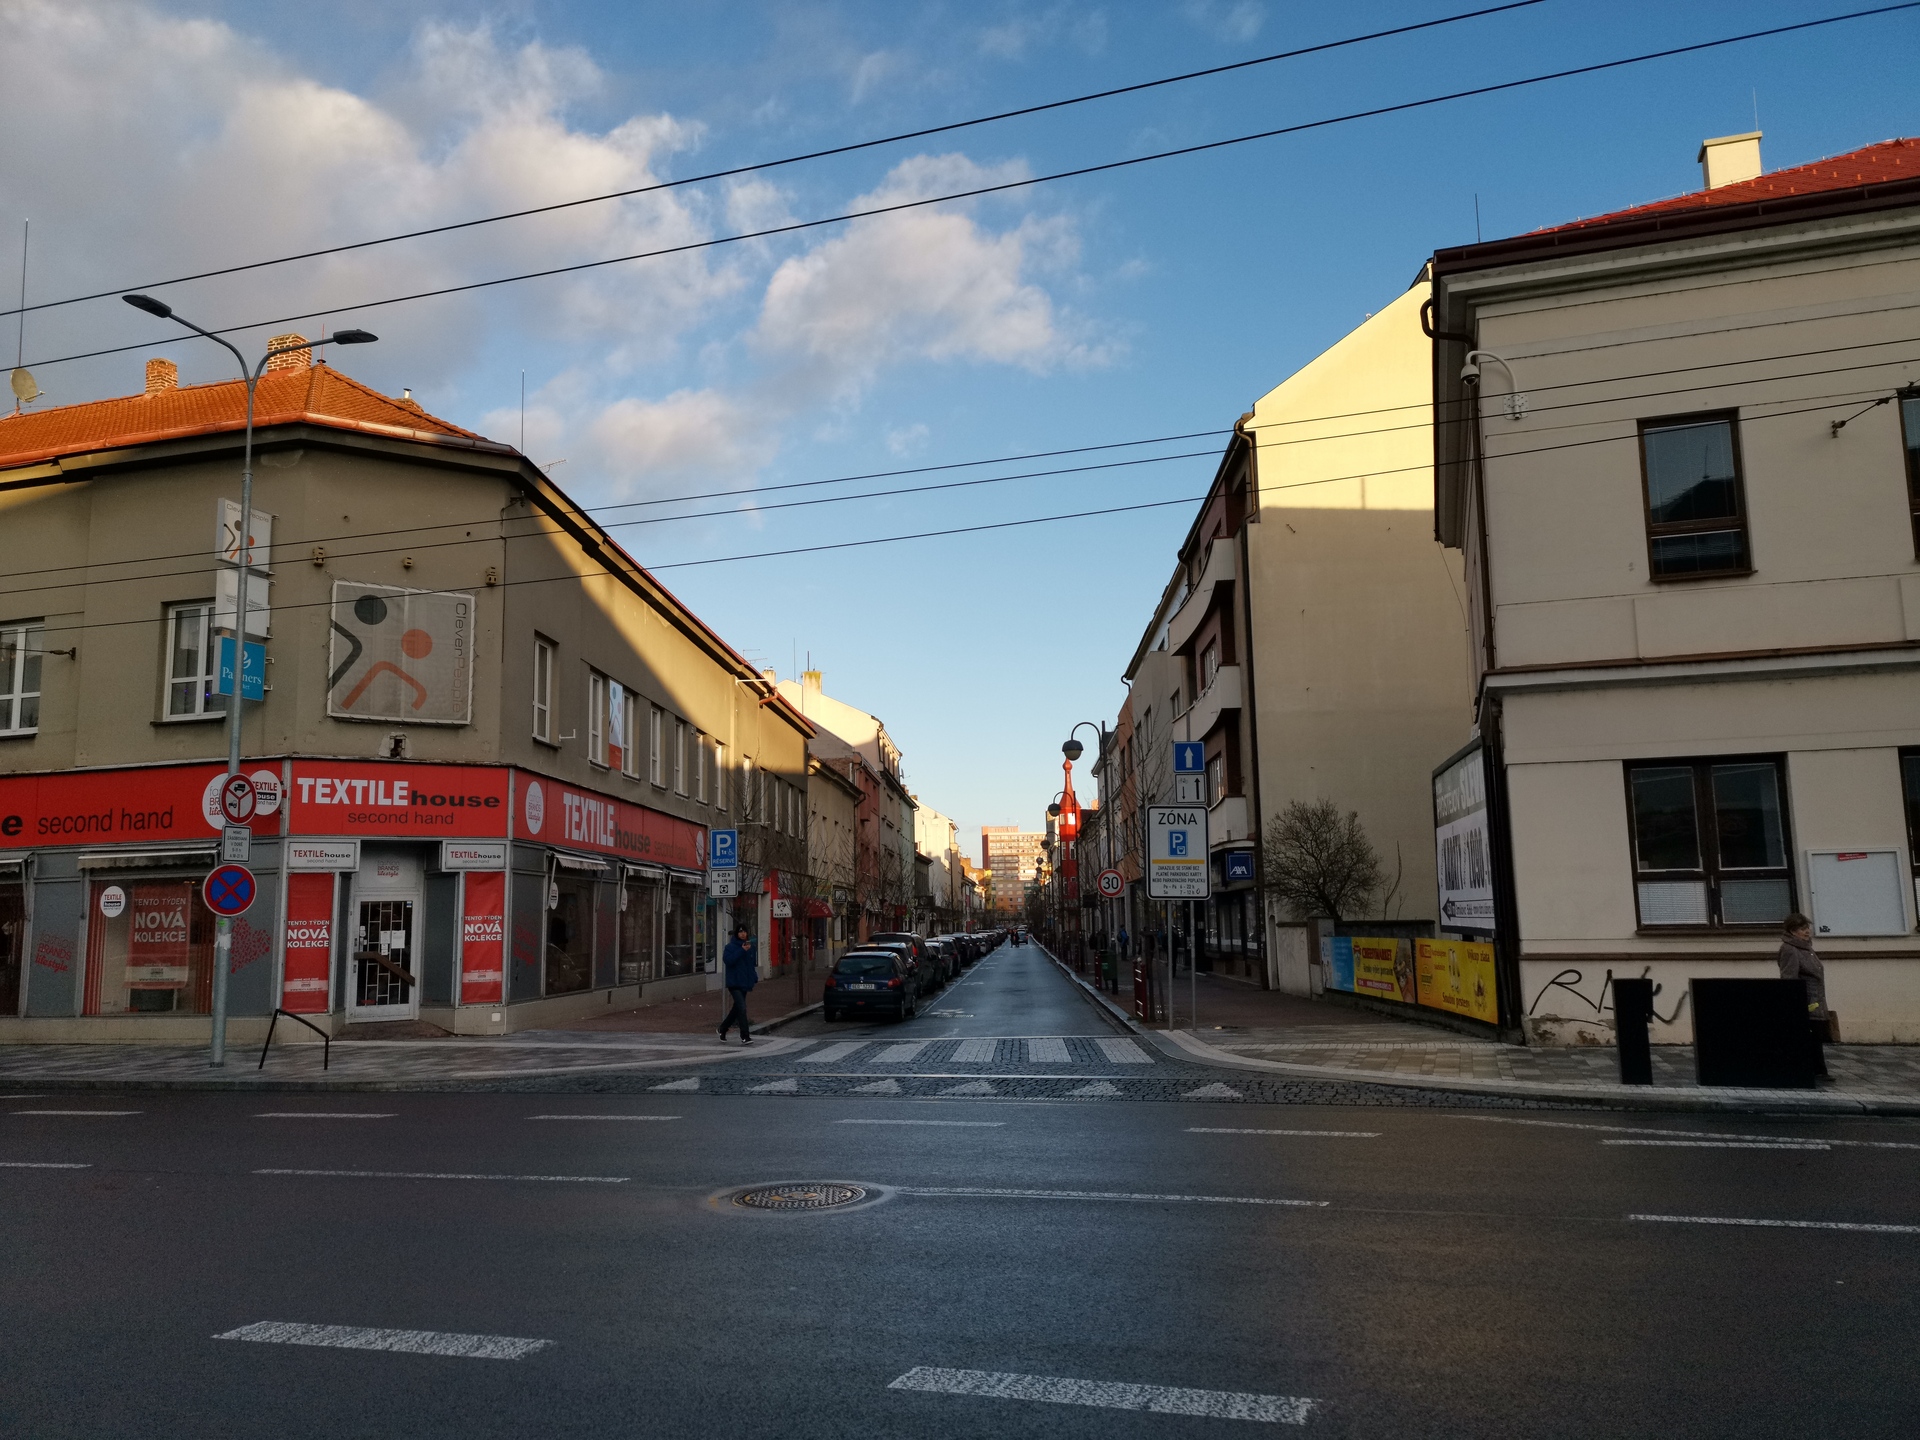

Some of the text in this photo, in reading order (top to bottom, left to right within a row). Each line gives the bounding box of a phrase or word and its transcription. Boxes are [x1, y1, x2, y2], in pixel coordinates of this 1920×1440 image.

[226, 503, 269, 523] Cleveople
[222, 666, 262, 685] Paners
[38, 808, 113, 836] second
[120, 806, 173, 831] hand
[348, 810, 454, 825] second hand
[1158, 810, 1198, 825] ZÓNA
[1230, 866, 1248, 875] AXA
[1103, 877, 1119, 889] 30
[134, 896, 186, 906] TENTO TÝDEN
[134, 907, 186, 929] NOVÁ
[288, 926, 329, 940] NOVÁ
[465, 920, 502, 934] NOVÁ
[134, 931, 187, 942] KOLEKCE
[287, 940, 330, 948] KOLEKCE
[38, 943, 72, 961] BRANDS
[35, 953, 68, 973] lifestyle
